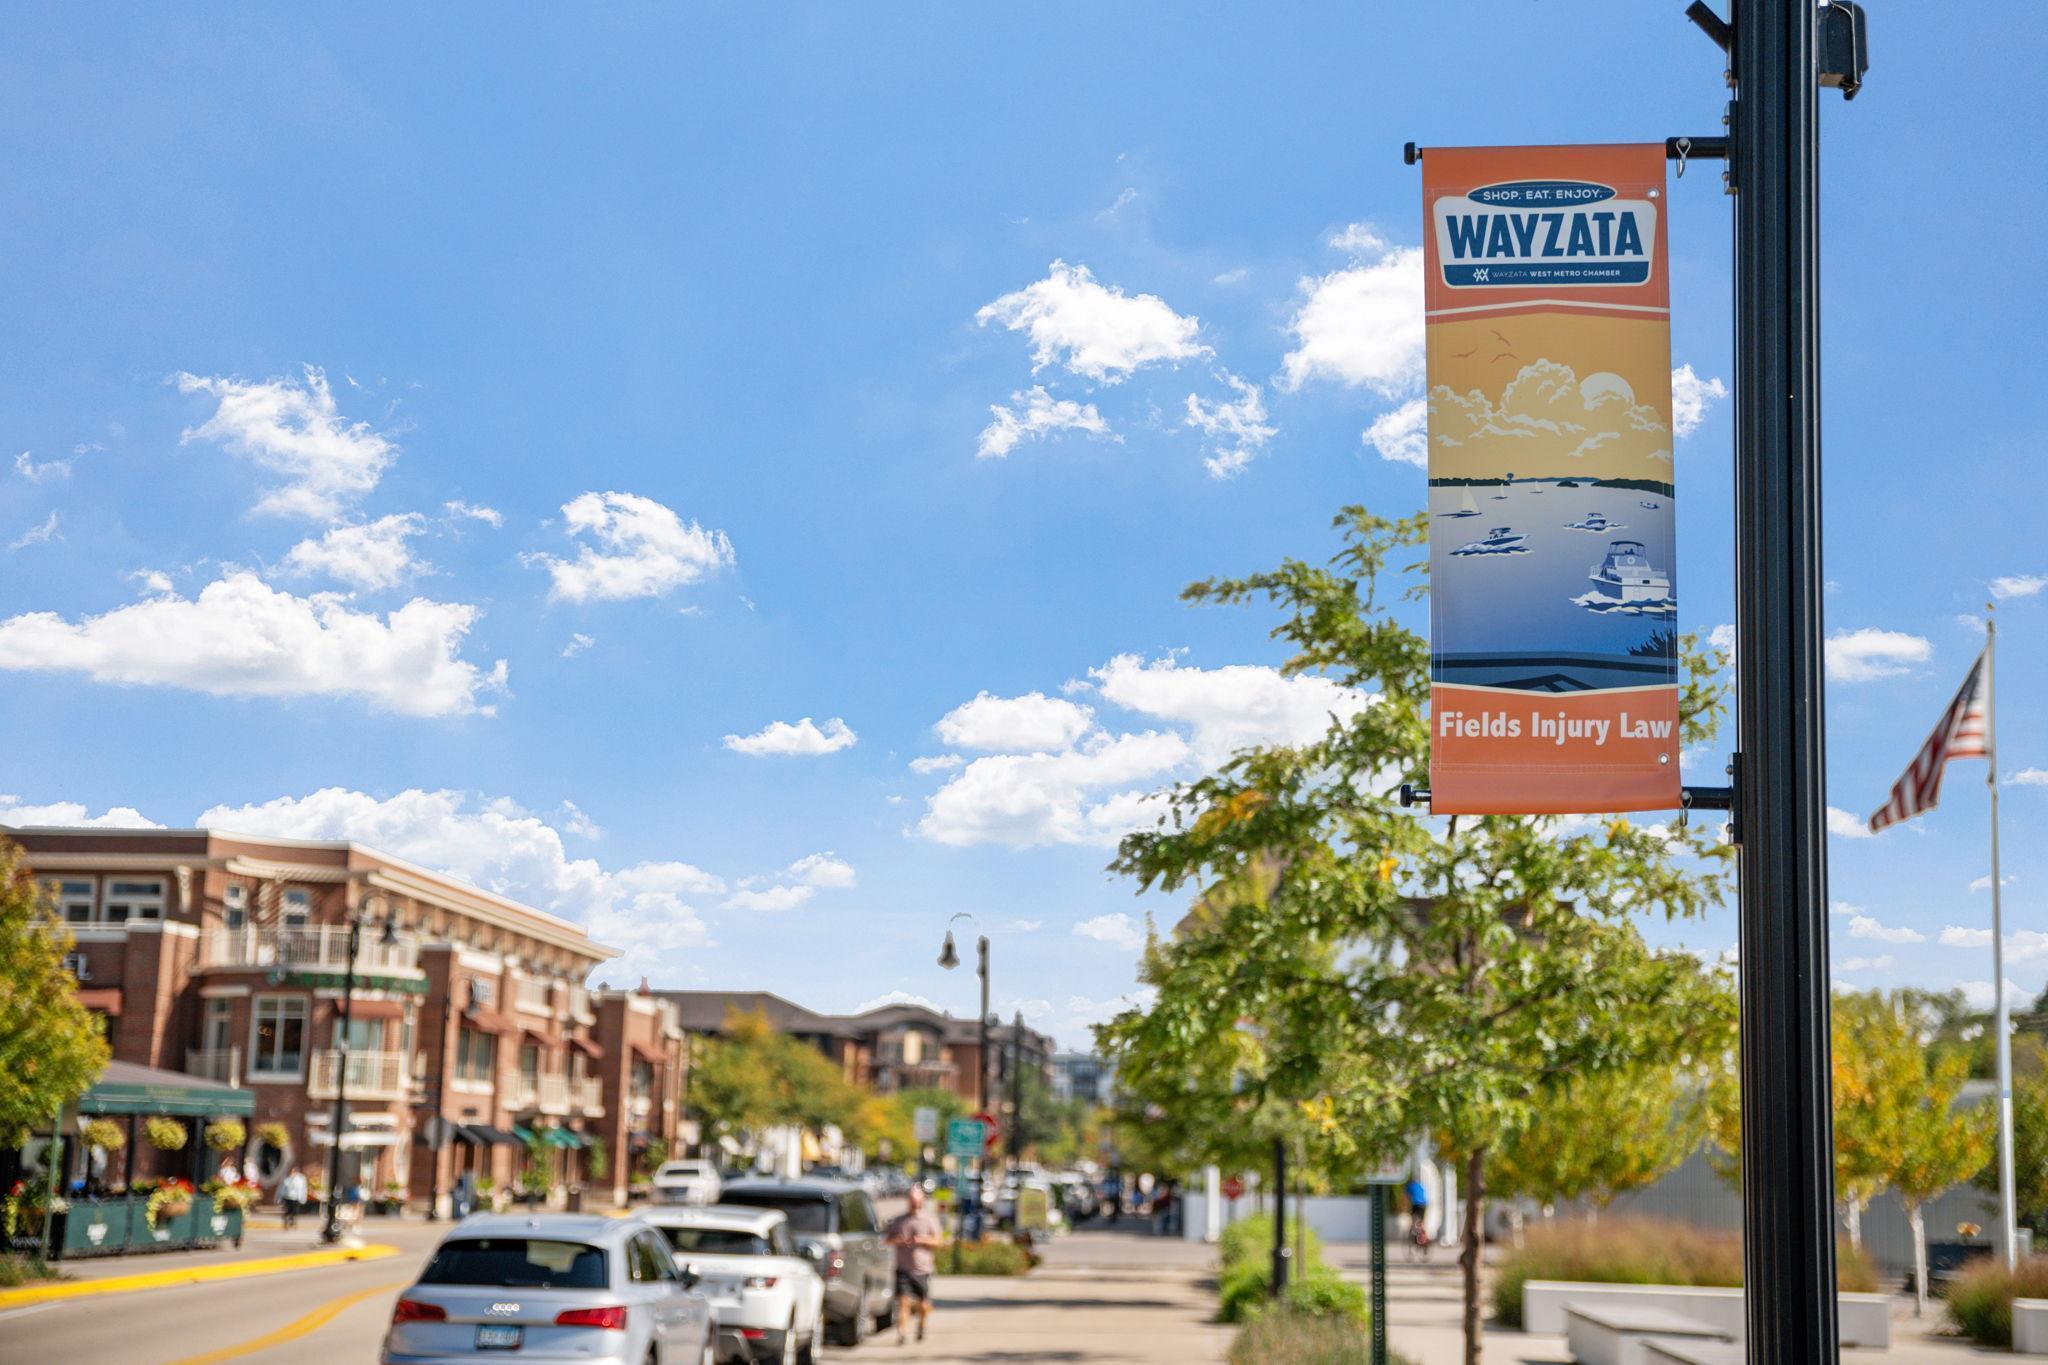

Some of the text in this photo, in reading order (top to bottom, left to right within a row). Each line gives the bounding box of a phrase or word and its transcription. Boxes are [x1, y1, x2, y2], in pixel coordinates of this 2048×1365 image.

[1483, 188, 1603, 200] SHOP. EAT. ENJOY.
[1446, 211, 1644, 259] WAYZATA
[1491, 270, 1528, 278] WAYZATA
[1530, 270, 1552, 278] WEST
[1583, 269, 1620, 277] CHAMBER
[1439, 711, 1672, 746] Fields Injury Law
